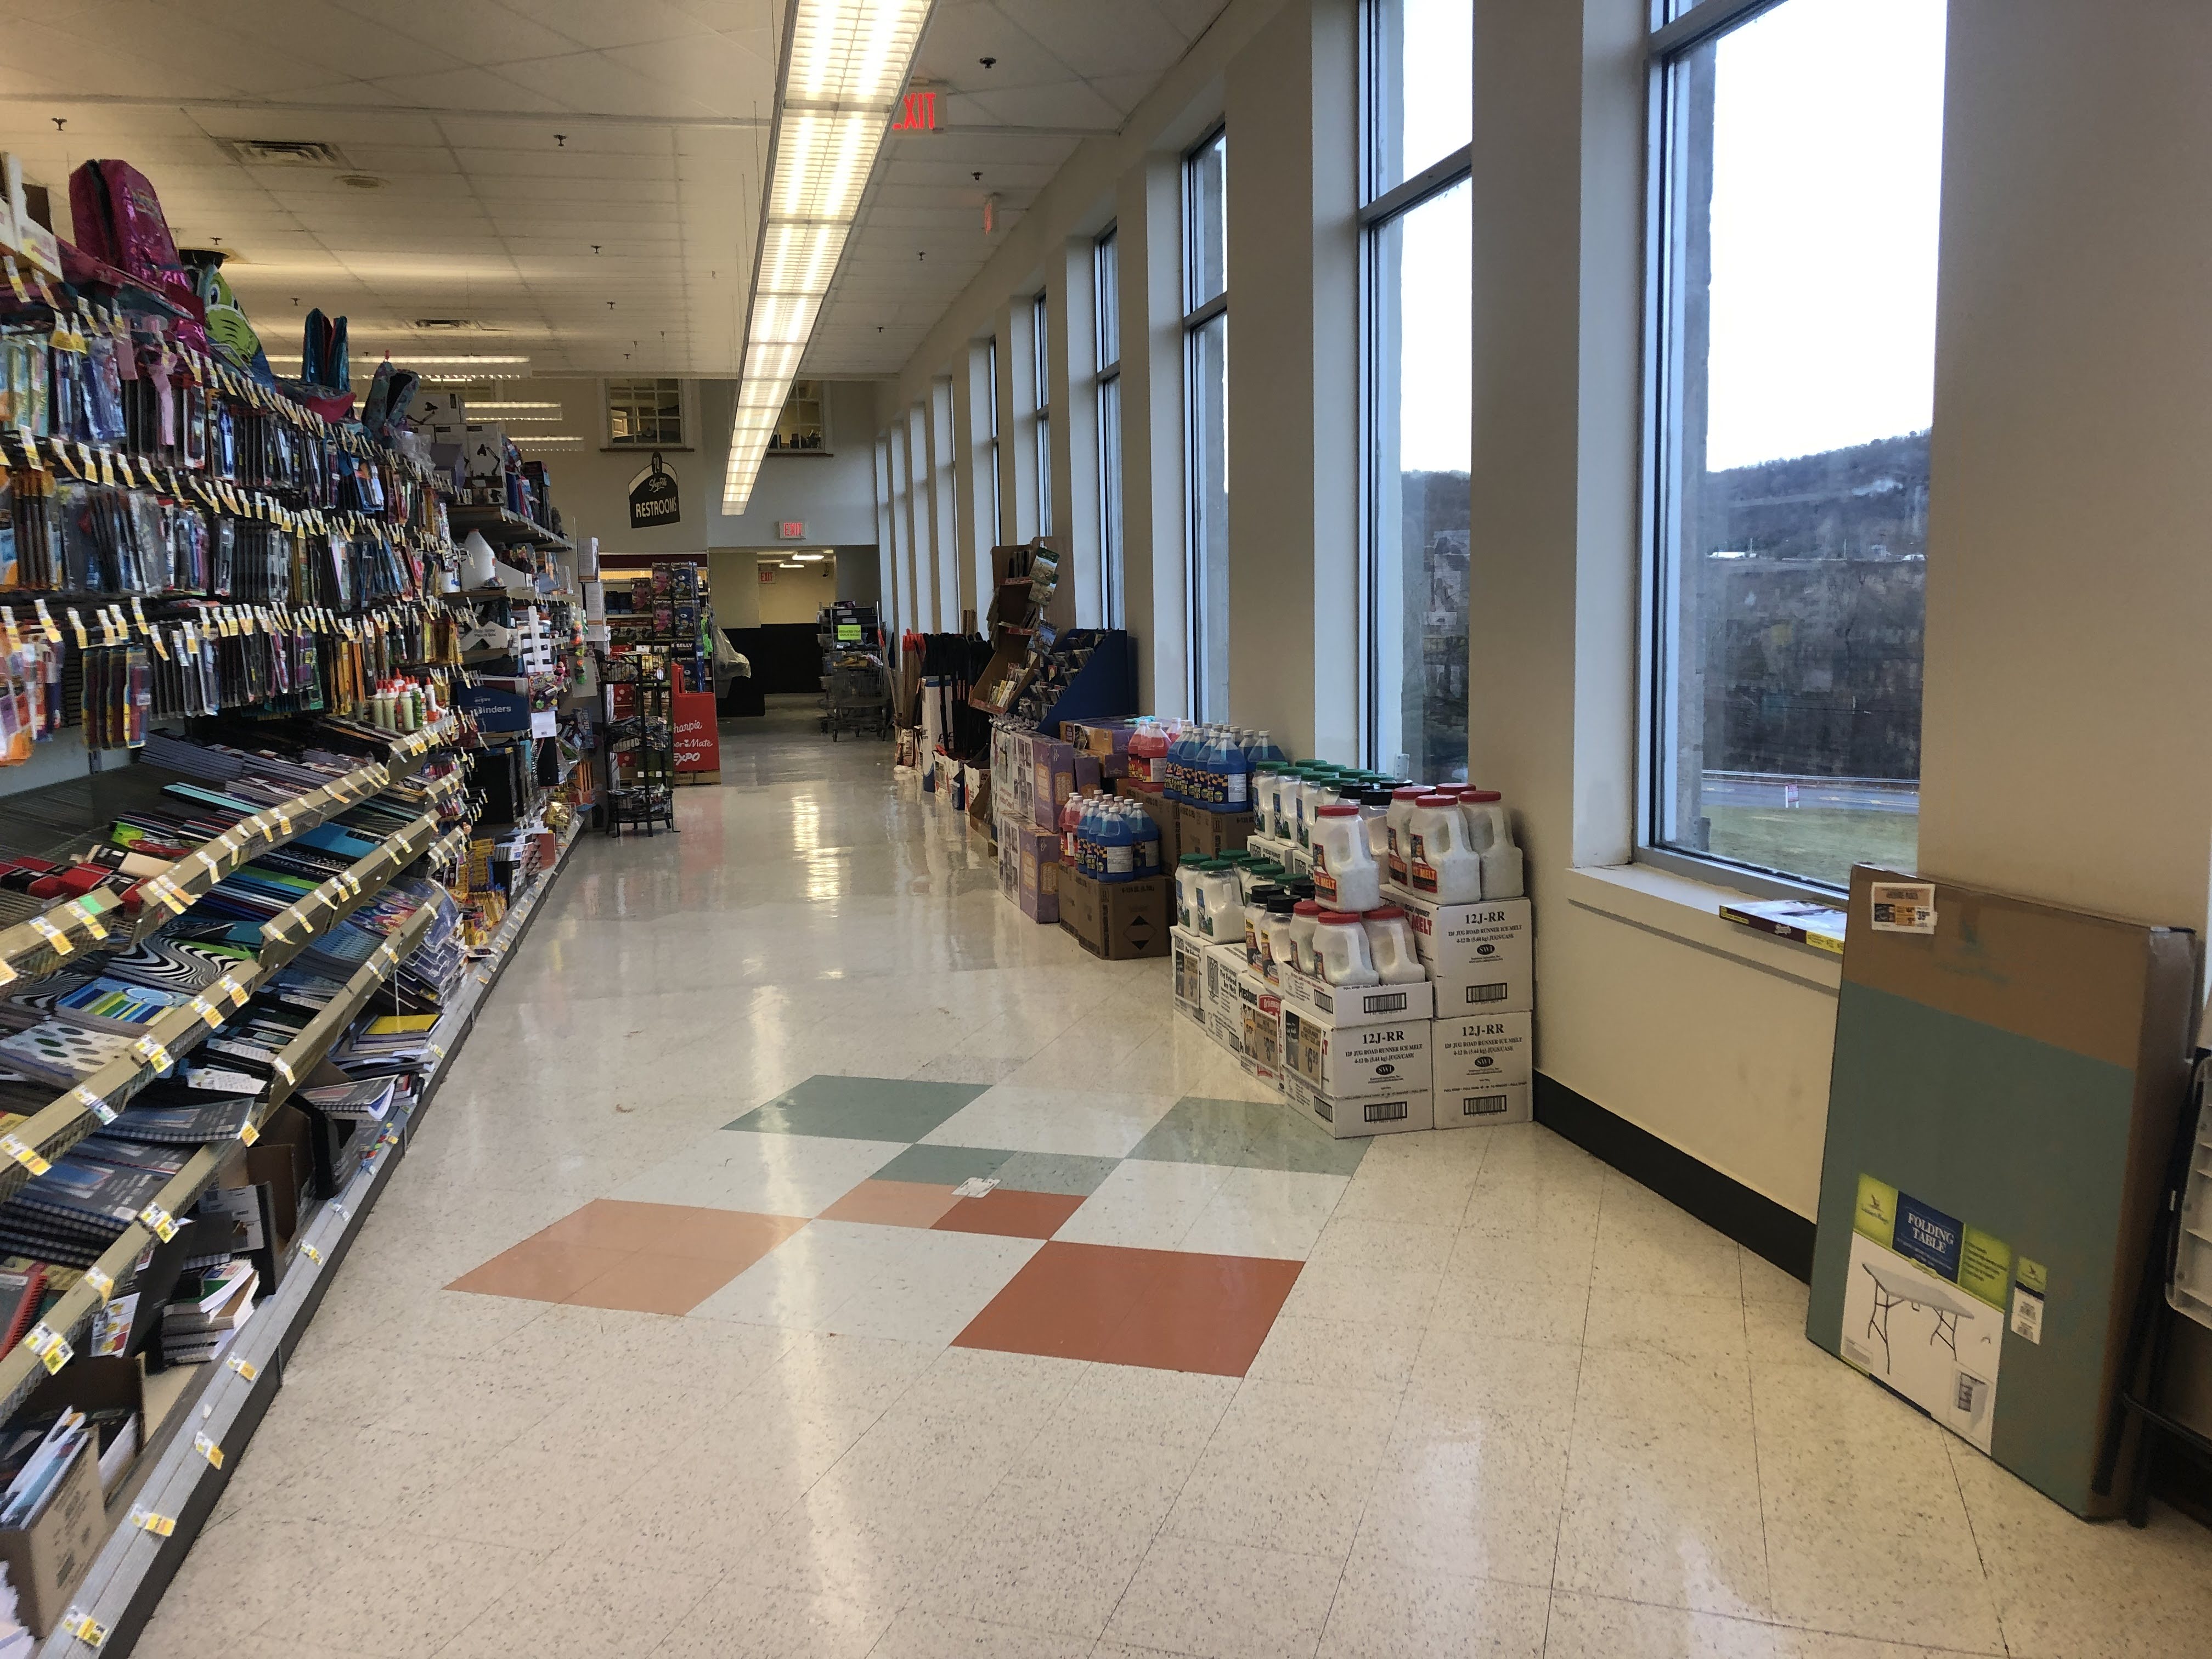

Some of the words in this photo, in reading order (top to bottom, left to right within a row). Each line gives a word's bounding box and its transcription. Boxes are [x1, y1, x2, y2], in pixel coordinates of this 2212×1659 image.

[893, 92, 936, 129] XIT
[635, 496, 677, 518] RESTROOMS
[783, 522, 803, 537] EXIT
[760, 572, 773, 582] EXIT
[673, 720, 703, 734] harpie
[1420, 869, 1436, 881] MELT
[1411, 913, 1432, 936] MELT
[1465, 911, 1505, 924] 12J-RR
[1362, 1030, 1405, 1044] 12J-RR
[1462, 1024, 1504, 1036] 12J-RR
[1908, 1212, 1955, 1245] FOLDING
[1912, 1227, 1947, 1254] TABLE
